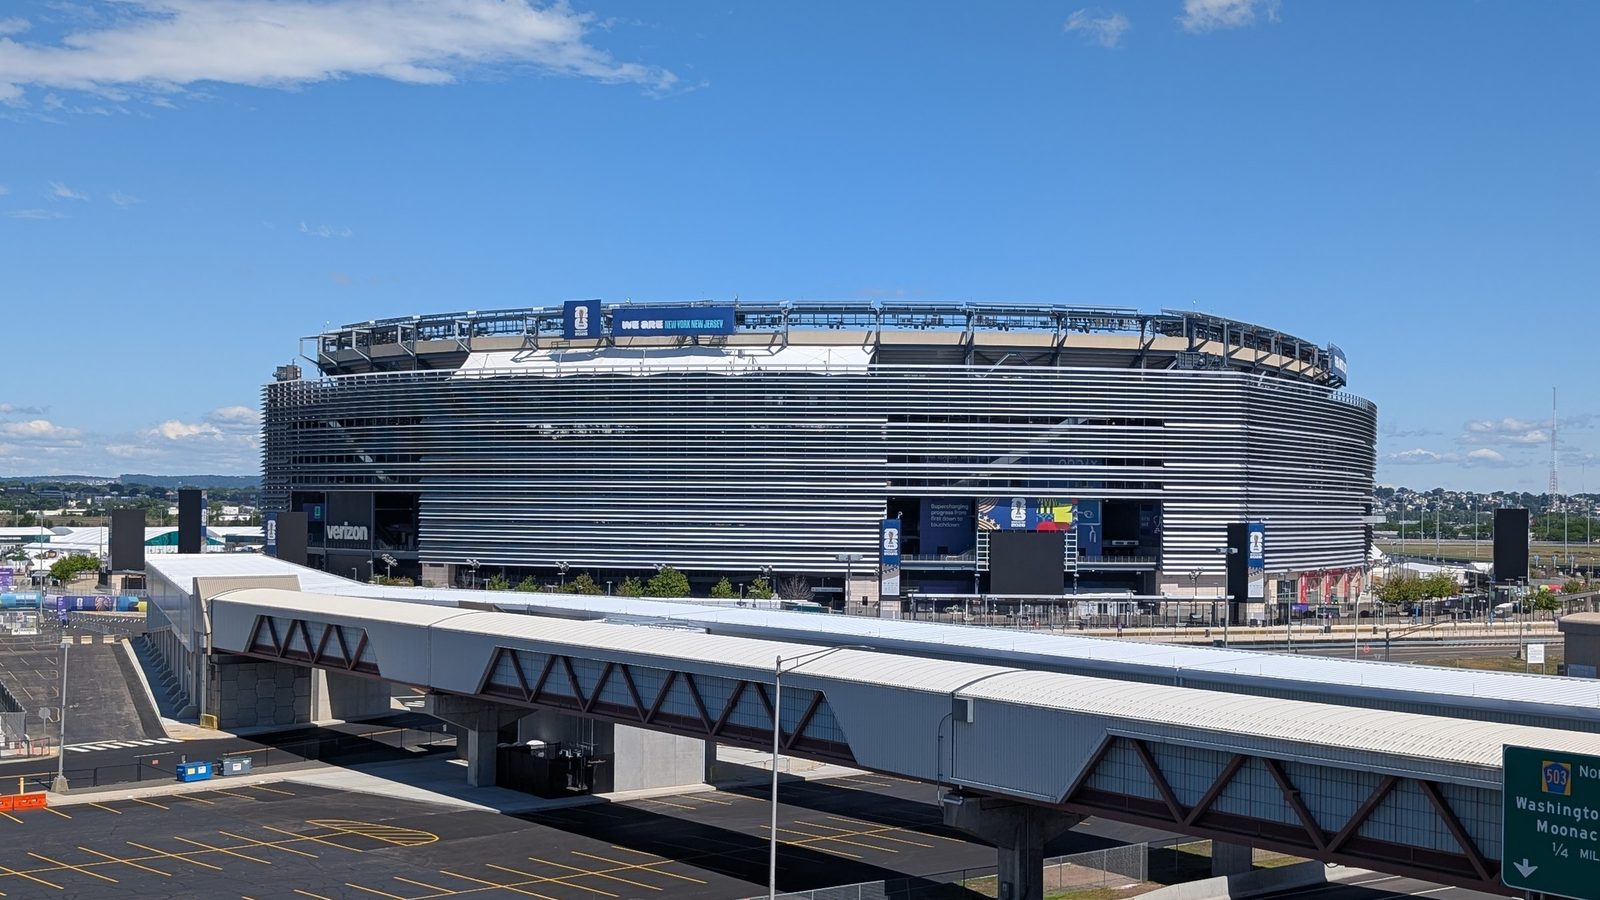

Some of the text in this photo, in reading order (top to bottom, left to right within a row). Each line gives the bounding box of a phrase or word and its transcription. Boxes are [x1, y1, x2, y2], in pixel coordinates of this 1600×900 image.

[622, 320, 724, 329] WE ARE NEW YORK NEW JERSEY
[326, 521, 368, 540] verizon
[1546, 769, 1567, 785] 503
[1516, 796, 1599, 822] Washingto
[1537, 820, 1598, 841] Moonac
